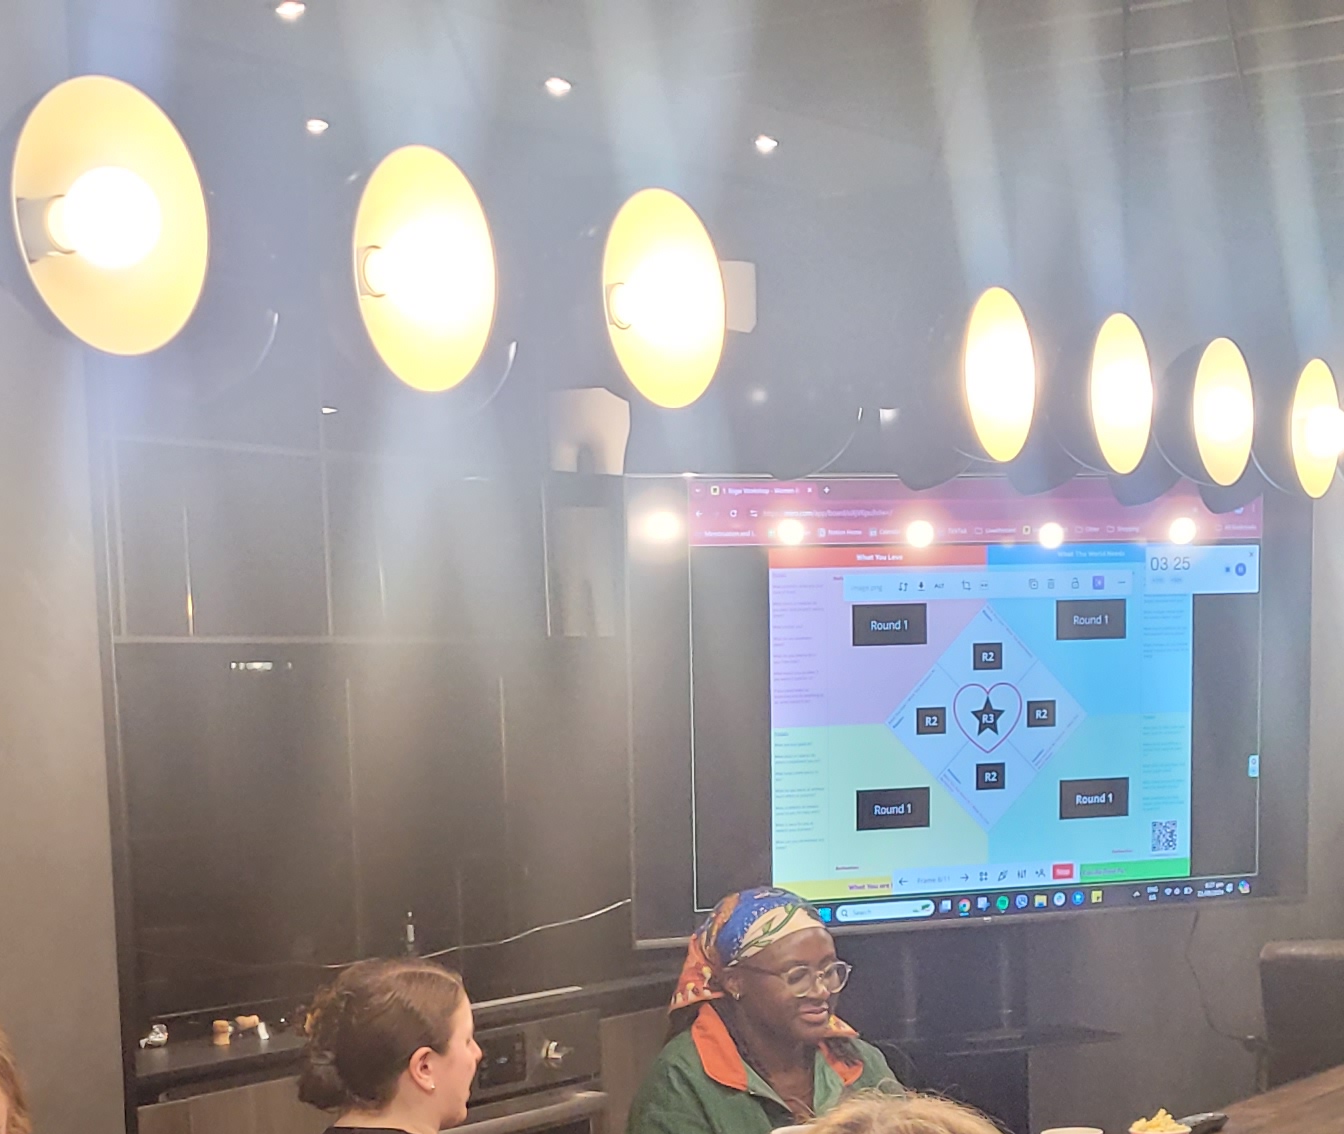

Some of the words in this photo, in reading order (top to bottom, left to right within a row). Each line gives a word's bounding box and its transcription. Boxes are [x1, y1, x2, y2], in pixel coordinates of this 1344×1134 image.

[856, 553, 874, 561] What
[874, 553, 887, 561] You
[1150, 556, 1169, 571] 03
[1173, 556, 1191, 571] 25
[870, 620, 901, 632] Round
[904, 619, 909, 631] 1
[1073, 615, 1102, 626] Round
[1104, 614, 1109, 625] 1
[981, 652, 995, 662] R2
[981, 713, 995, 724] R3
[1035, 709, 1049, 719] R2
[925, 717, 939, 727] R2
[984, 772, 998, 782] R2
[1075, 793, 1106, 805] Round
[1107, 792, 1113, 803] 1
[874, 804, 905, 816] Round
[906, 803, 912, 814] 1
